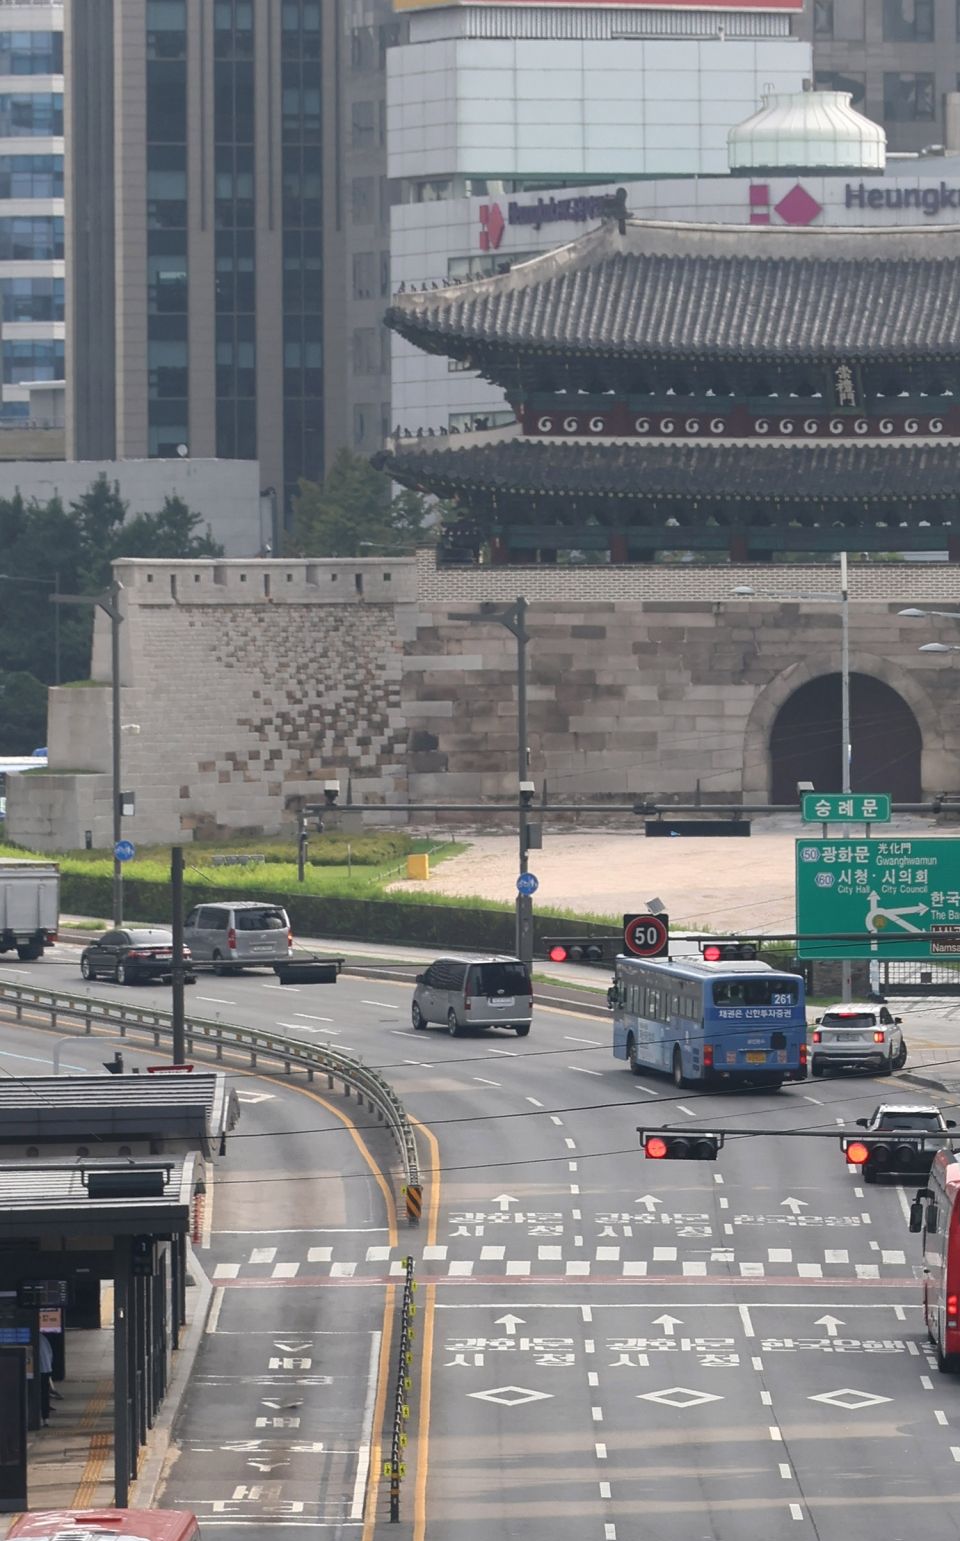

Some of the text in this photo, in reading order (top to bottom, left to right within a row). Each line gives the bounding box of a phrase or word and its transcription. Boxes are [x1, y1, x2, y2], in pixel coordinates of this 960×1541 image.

[815, 799, 878, 817] 숭례문
[803, 846, 870, 863] 50 광화문
[877, 842, 911, 855] 光化門
[876, 856, 938, 867] Gwanghwamun
[818, 869, 929, 885] 60 시청 시의회
[837, 885, 928, 895] City Hall City Council
[930, 910, 946, 920] The
[634, 926, 658, 946] 50
[774, 993, 792, 1005] 261
[444, 1337, 575, 1351] 광화문
[605, 1337, 736, 1351] 광화문
